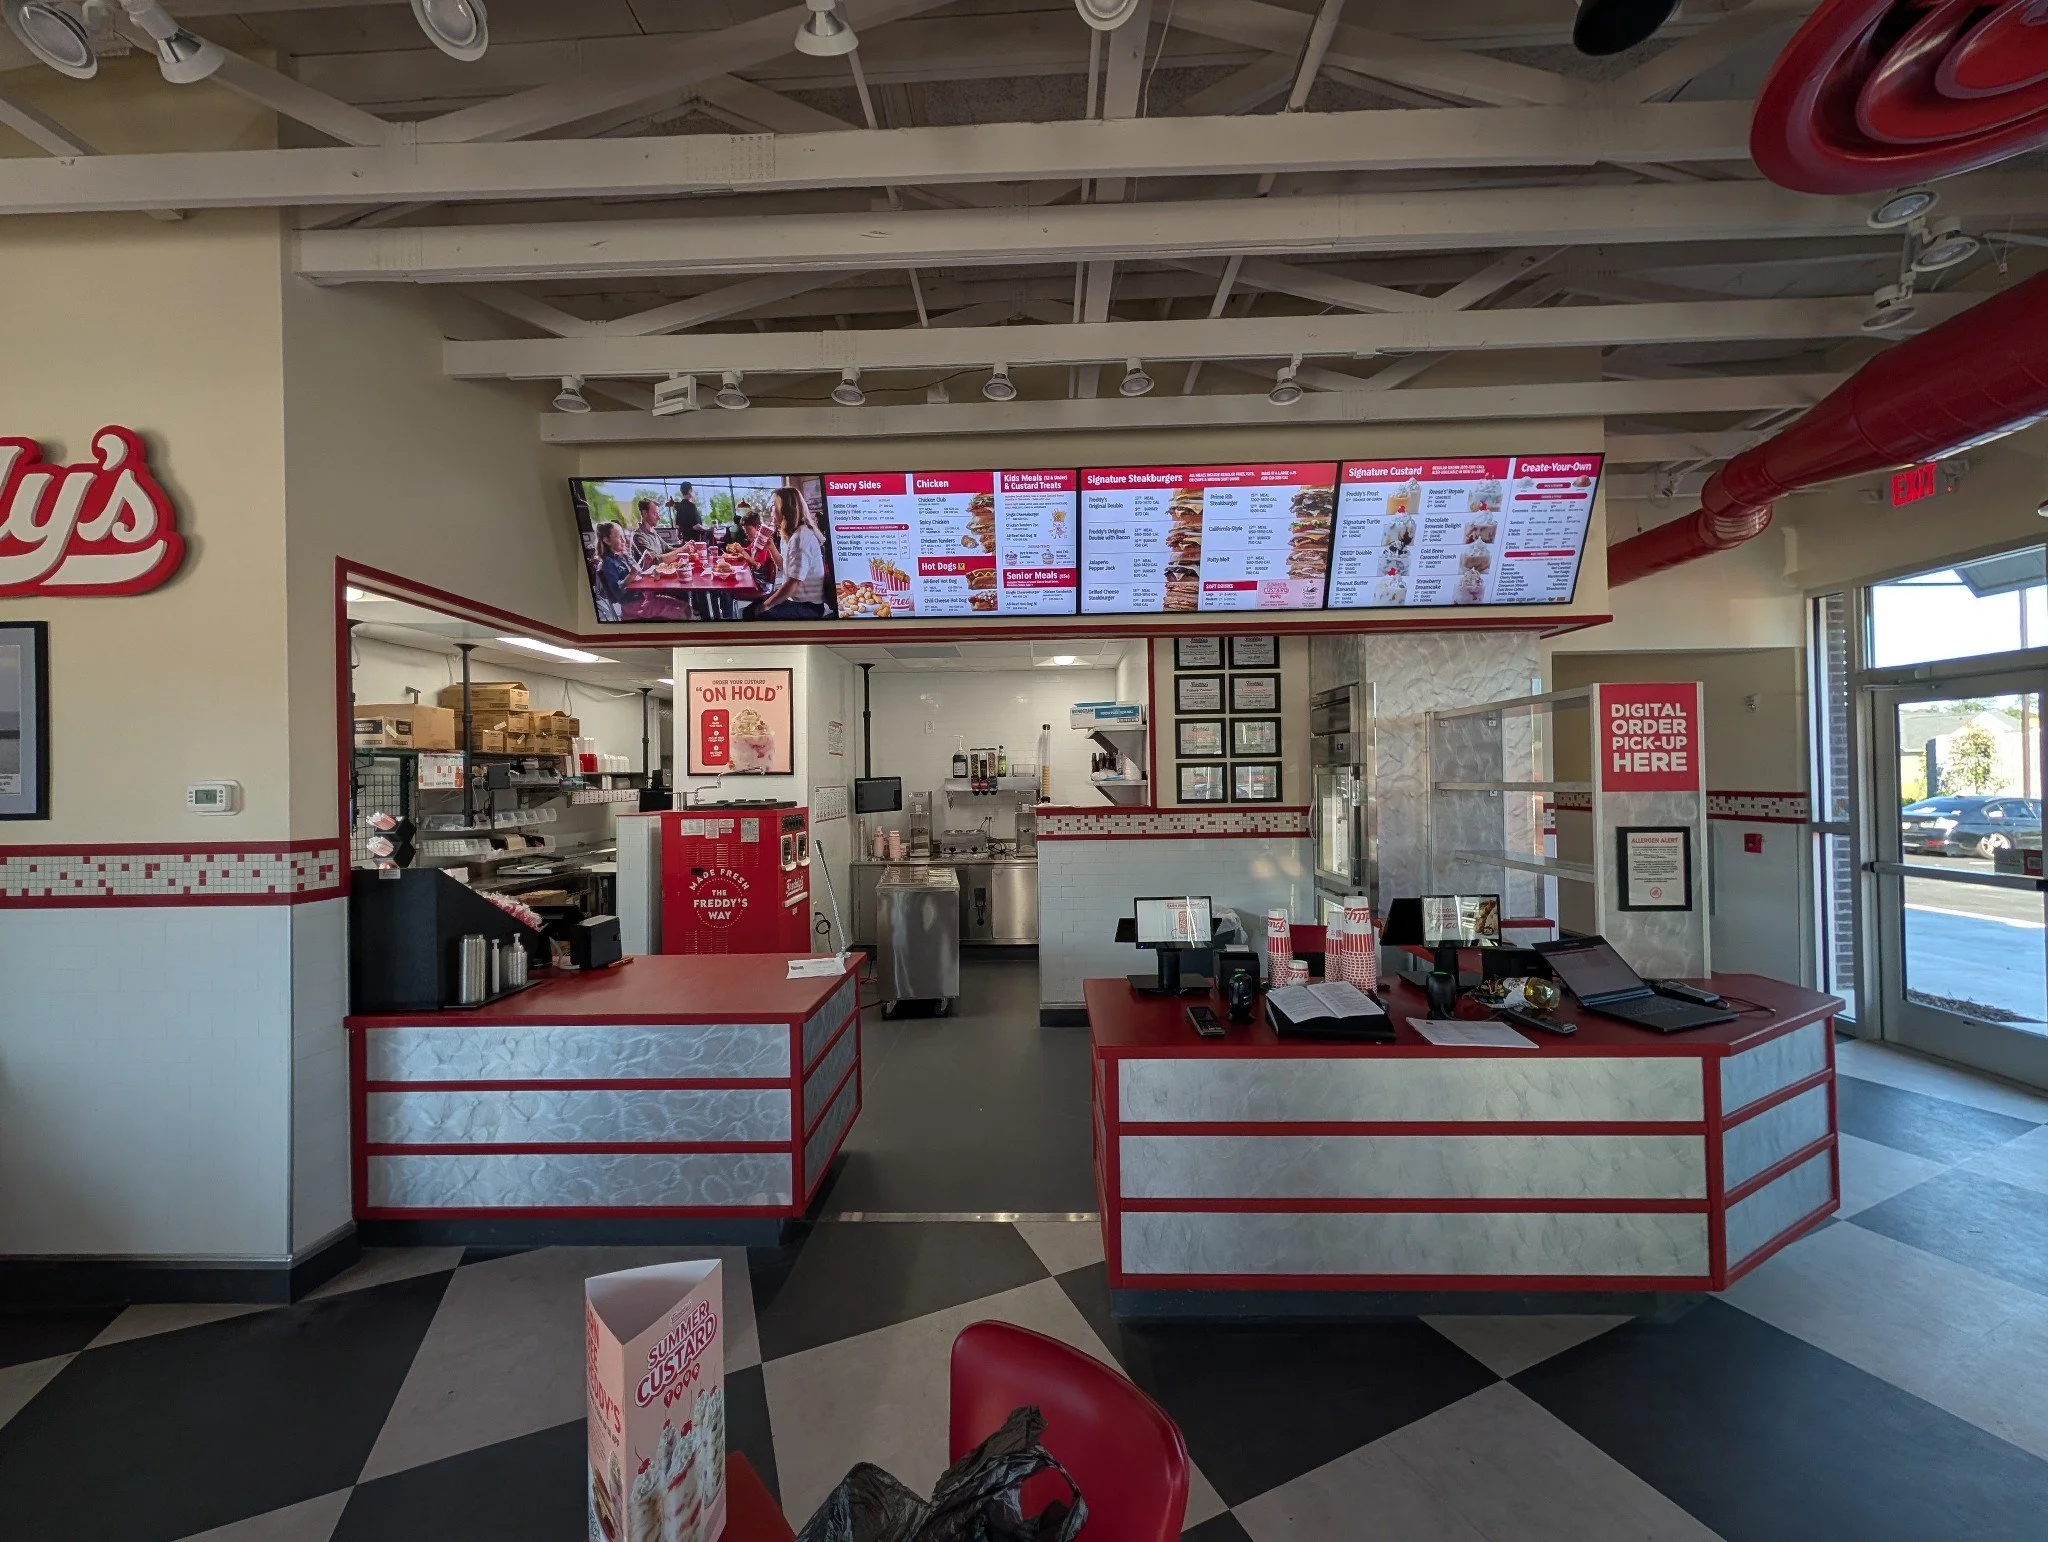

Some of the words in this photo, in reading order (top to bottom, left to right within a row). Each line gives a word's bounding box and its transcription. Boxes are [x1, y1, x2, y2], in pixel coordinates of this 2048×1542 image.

[1348, 468, 1388, 478] Signature
[1390, 466, 1423, 476] Custard
[1521, 462, 1592, 472] Create-Your-Own
[917, 479, 949, 487] Chicken
[1087, 475, 1127, 485] Signature
[1128, 474, 1183, 484] Steakburgers
[1892, 463, 1936, 507] EXIT
[829, 481, 857, 491] Savory
[858, 481, 881, 489] Sides
[938, 562, 957, 571] Dogs
[1007, 572, 1033, 580] Senior
[1034, 571, 1058, 579] Meals
[1611, 703, 1686, 718] DIGITAL
[1611, 719, 1686, 735] ORDER
[1612, 736, 1687, 750] PICK-UP
[1613, 751, 1688, 772] HERE
[689, 869, 715, 891] MADE
[720, 869, 750, 890] FRESH
[693, 898, 748, 908] FREDDY'S
[708, 911, 732, 920] WAY
[648, 1300, 708, 1369] SUMMER
[636, 1315, 715, 1405] CUSTARD
